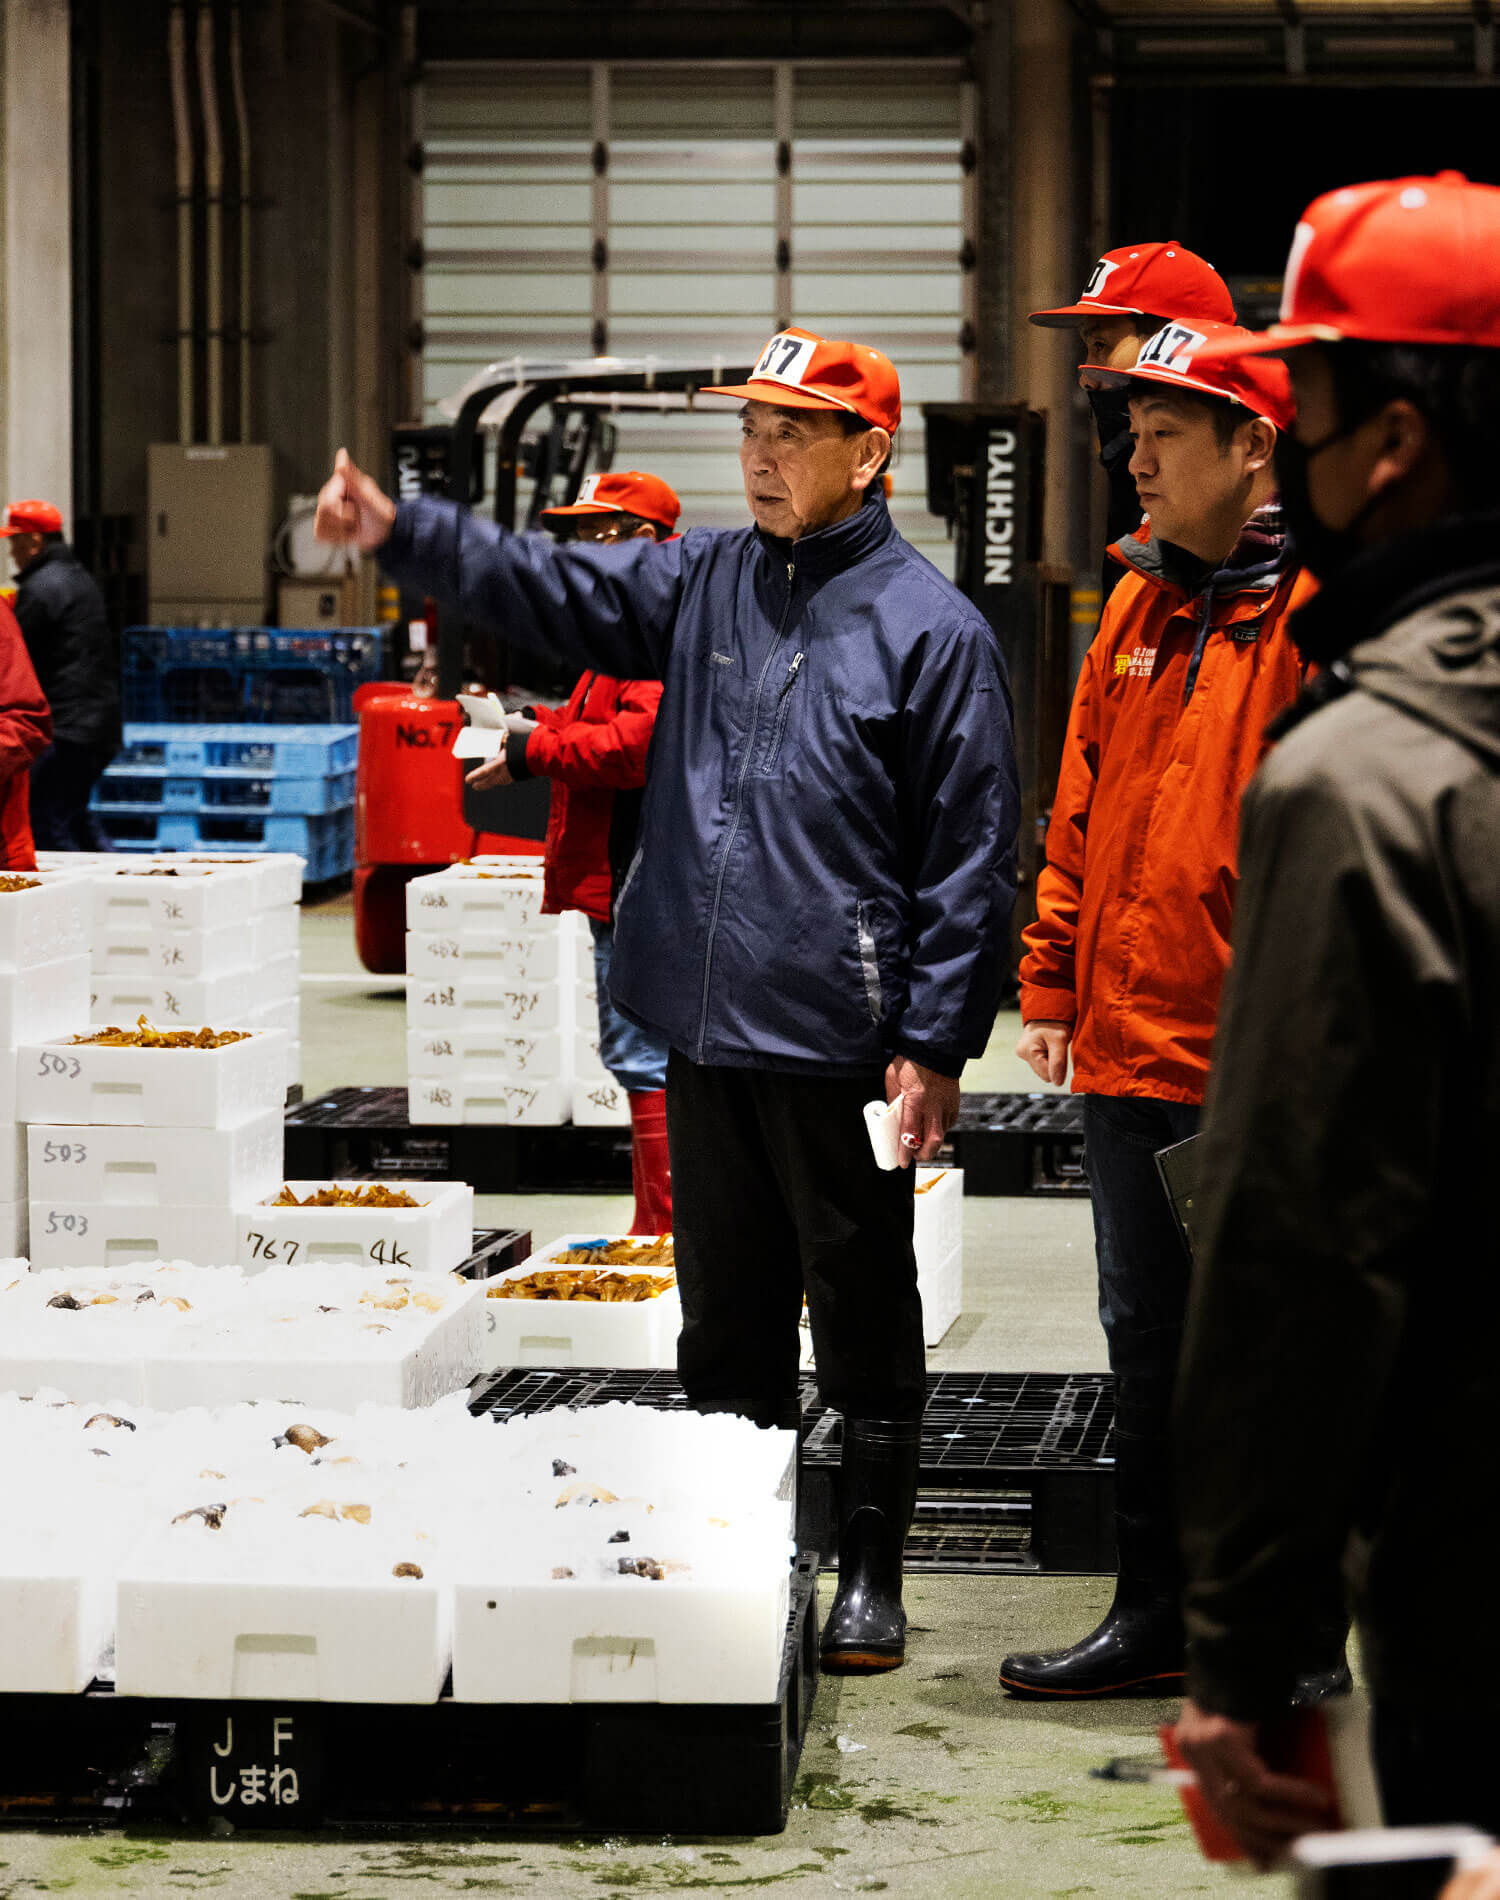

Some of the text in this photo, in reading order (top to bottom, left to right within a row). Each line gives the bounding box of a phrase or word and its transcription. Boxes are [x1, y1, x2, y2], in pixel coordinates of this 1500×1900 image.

[760, 337, 803, 375] 37
[984, 430, 1016, 585] NICHIYU
[38, 1052, 81, 1078] 503
[44, 1140, 87, 1164] 503
[46, 1210, 88, 1237] 503
[247, 1231, 299, 1265] 767
[210, 1764, 299, 1805] しまね
